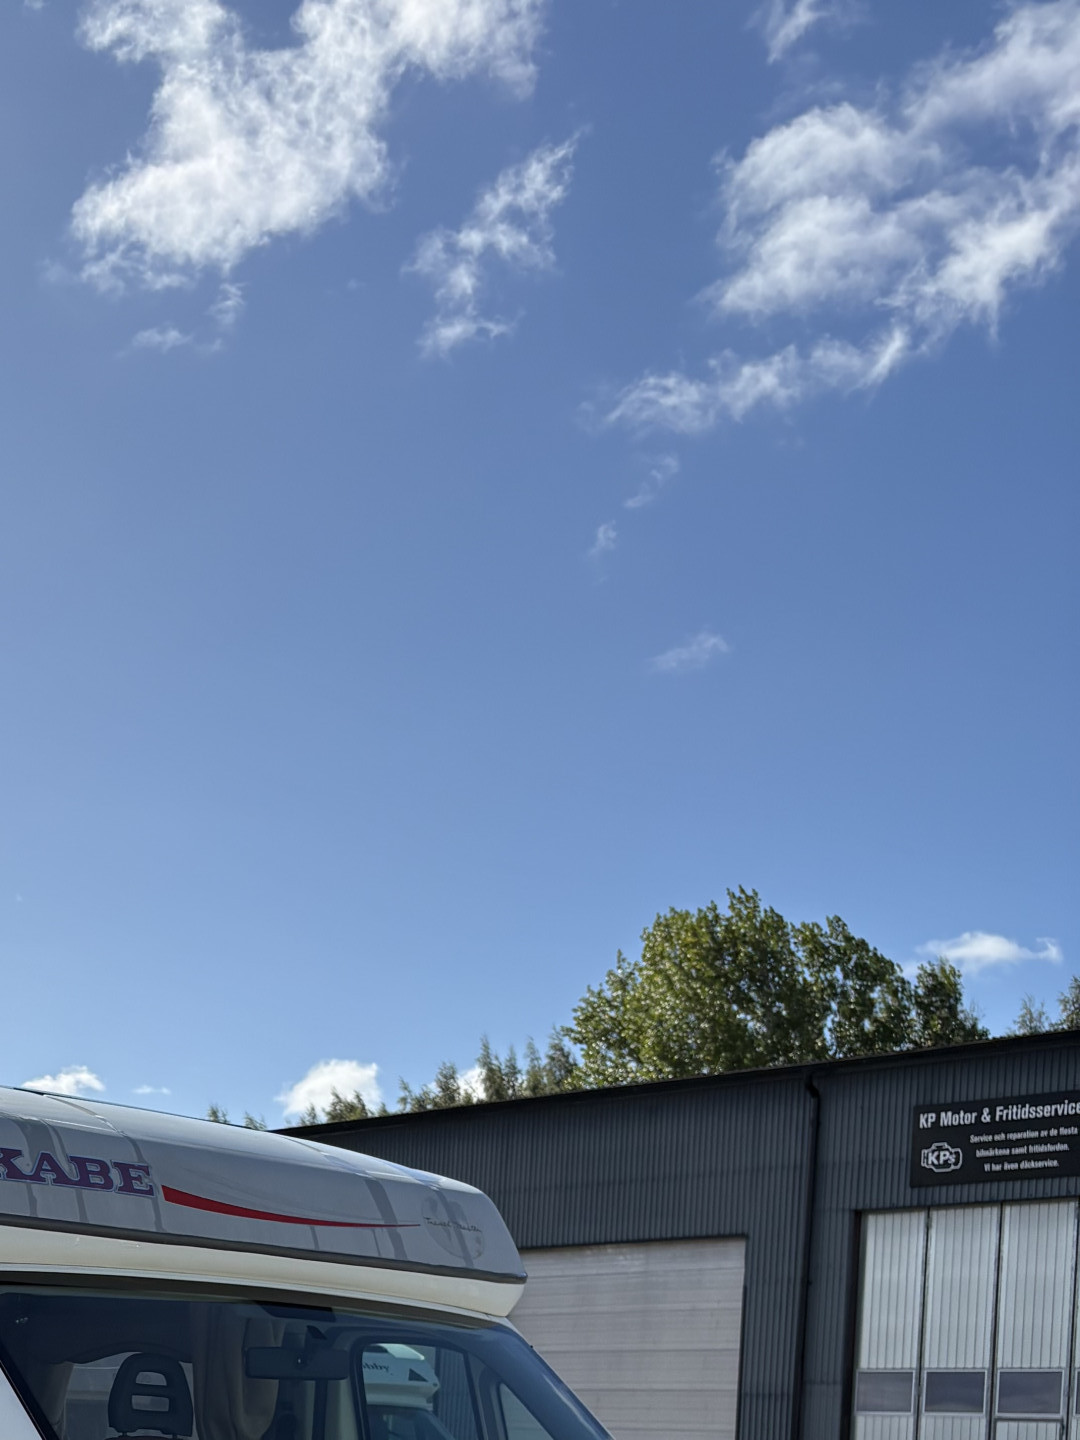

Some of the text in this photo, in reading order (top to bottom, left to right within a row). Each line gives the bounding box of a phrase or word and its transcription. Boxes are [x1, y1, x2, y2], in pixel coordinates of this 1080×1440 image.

[919, 1099, 1080, 1129] KP Motor & Fritidsservice
[969, 1133, 993, 1144] Service
